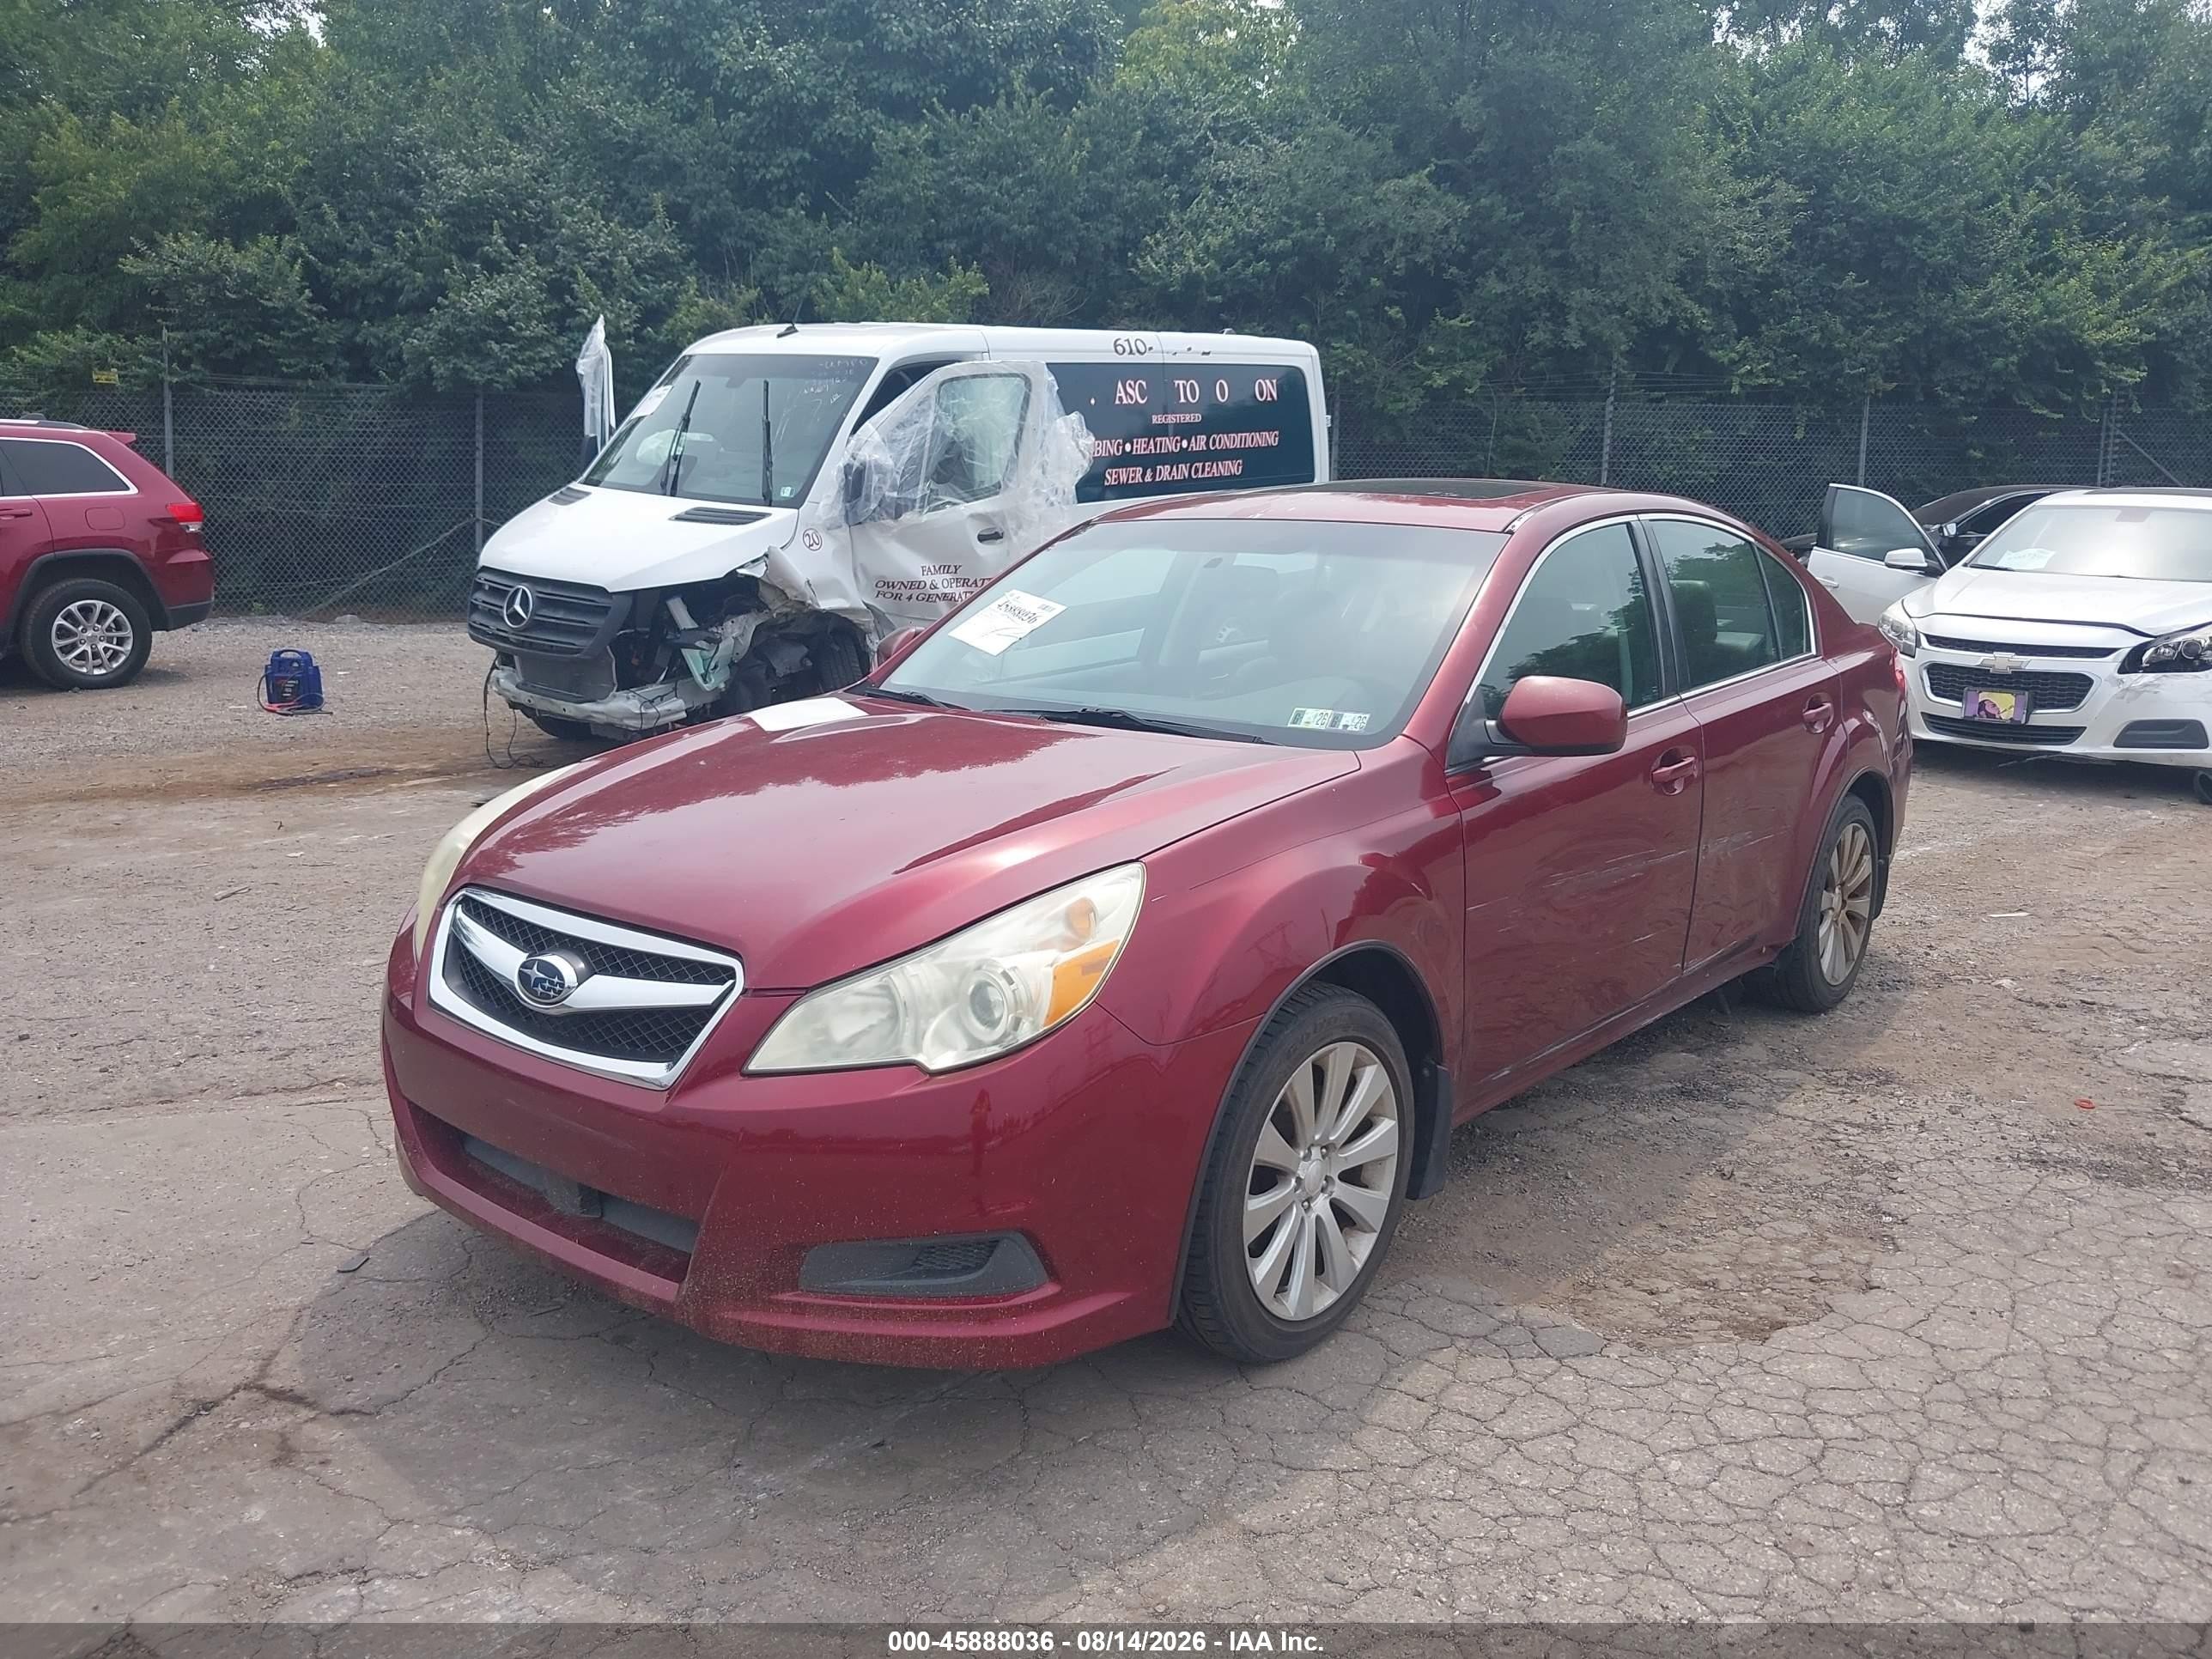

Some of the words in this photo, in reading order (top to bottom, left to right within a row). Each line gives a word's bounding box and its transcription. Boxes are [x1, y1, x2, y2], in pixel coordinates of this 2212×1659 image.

[1152, 413, 1202, 424] REGISTERED
[1093, 439, 1123, 457] BING
[1132, 436, 1182, 455] HEATING
[1188, 434, 1207, 452] AIR
[1209, 431, 1279, 450] CONDITIONING
[1104, 466, 1143, 486] SEWER
[1155, 463, 1190, 482] DRAIN
[1191, 459, 1243, 479] CLEANING
[805, 532, 820, 549] 20
[921, 564, 963, 576] FAMILY
[874, 579, 927, 591] OWNED
[929, 579, 939, 590] &
[941, 577, 994, 589] OPERAT
[874, 590, 902, 601] FOR
[905, 592, 914, 601] 4
[915, 591, 975, 603] GENERAT
